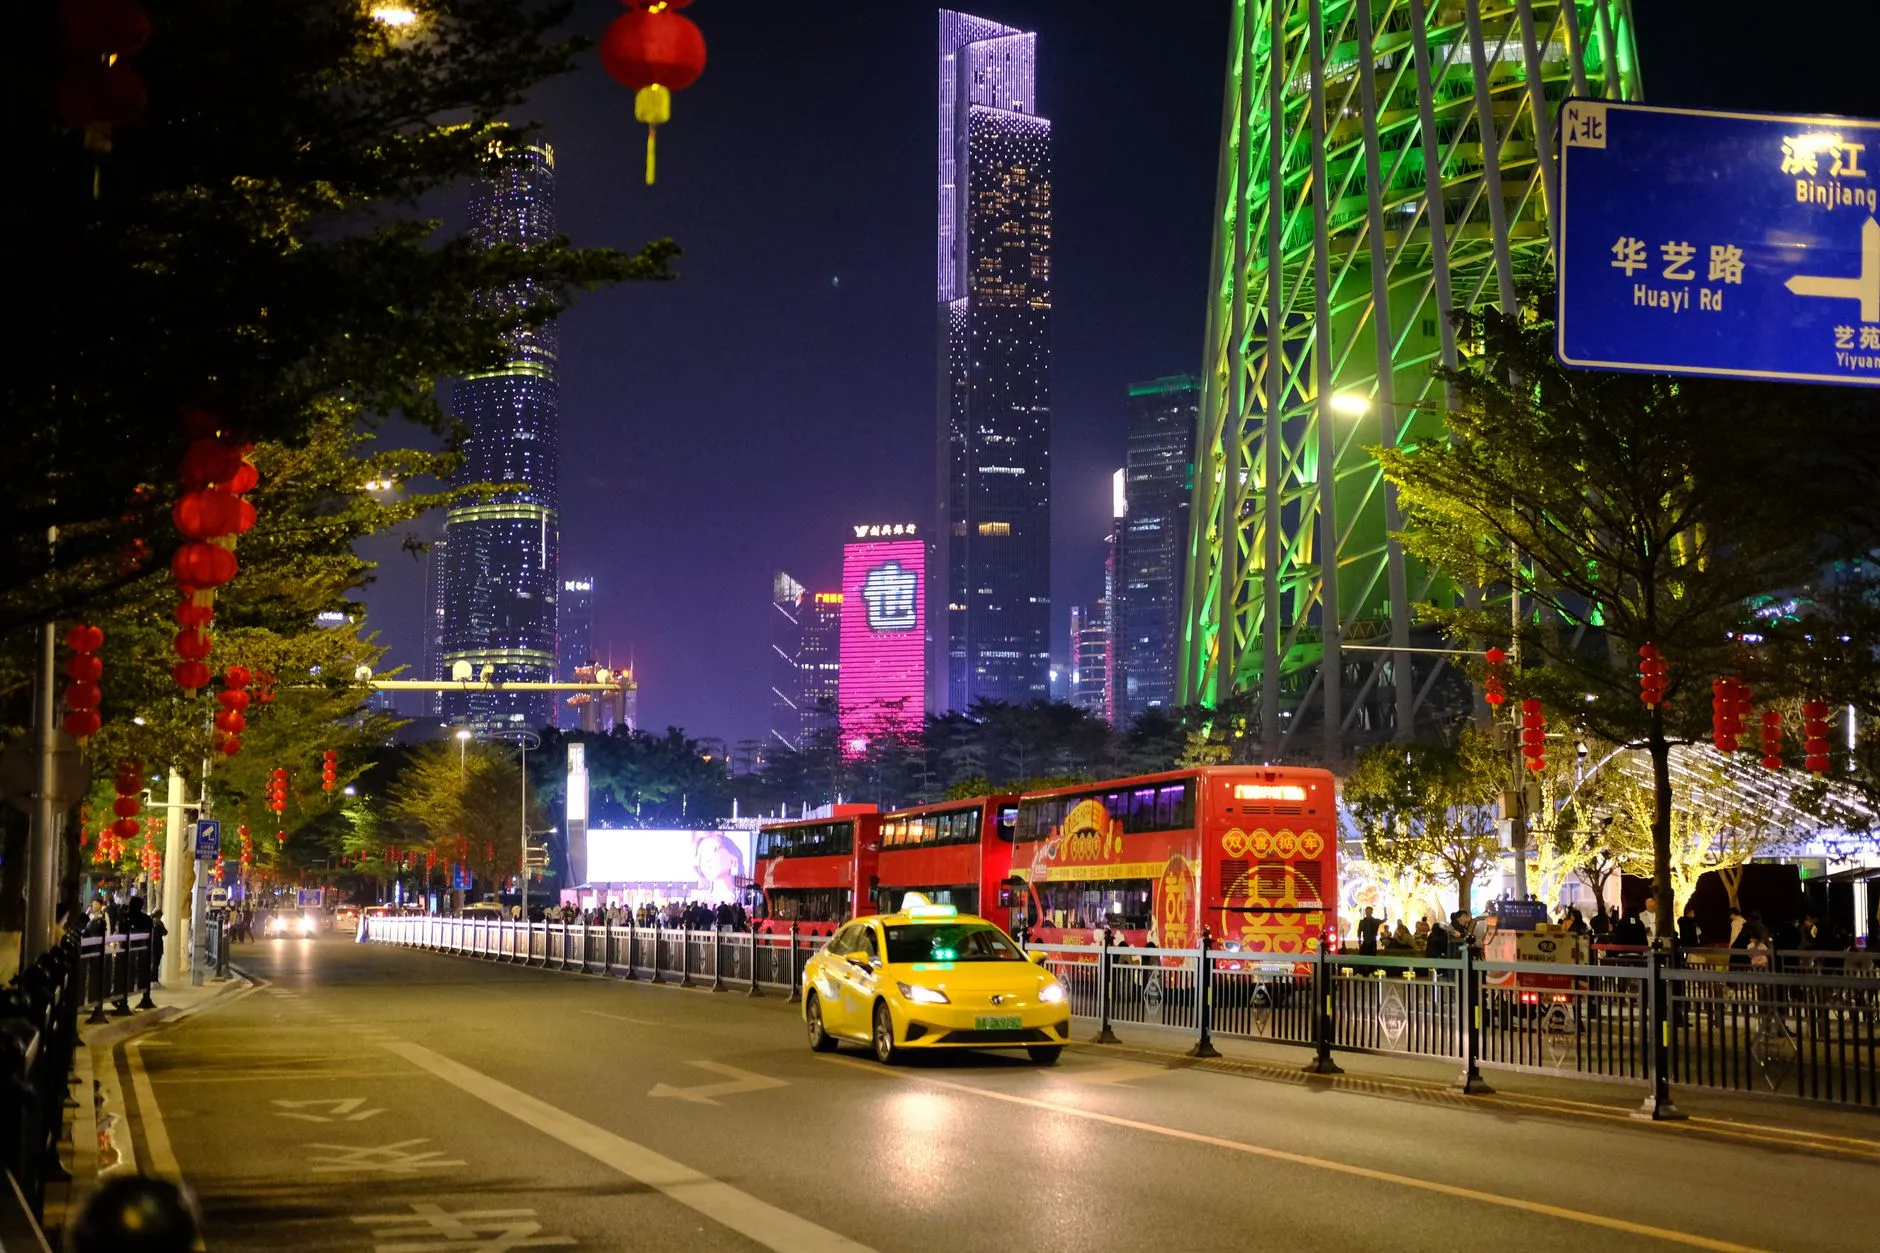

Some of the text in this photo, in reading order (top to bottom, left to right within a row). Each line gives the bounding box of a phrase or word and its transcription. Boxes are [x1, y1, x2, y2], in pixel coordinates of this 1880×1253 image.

[1568, 108, 1579, 121] N
[1581, 116, 1603, 140] 北
[1795, 180, 1877, 212] Binjiang
[1610, 236, 1746, 285] 华艺路
[1633, 284, 1722, 314] Huayi Rd
